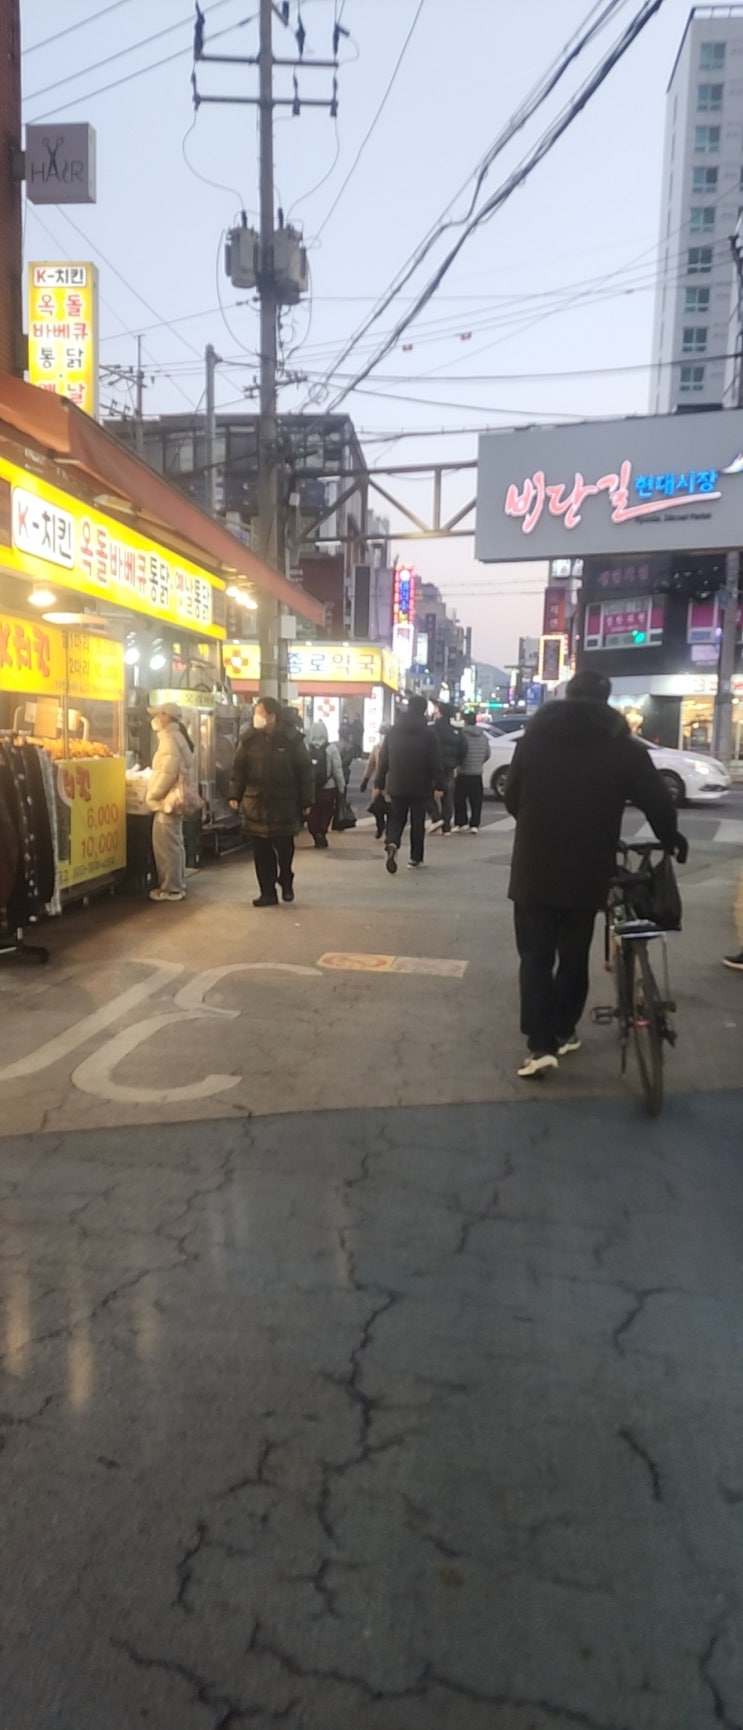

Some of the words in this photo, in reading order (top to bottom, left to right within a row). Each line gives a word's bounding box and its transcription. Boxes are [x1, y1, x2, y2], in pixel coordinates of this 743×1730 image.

[36, 268, 84, 285] K-치킨
[33, 322, 88, 339] 바베큐
[504, 459, 632, 534] 비단길
[634, 468, 718, 499] 현대시장
[18, 500, 72, 560] K-치킨
[87, 803, 119, 829] 6,000
[81, 830, 119, 859] 10,000
